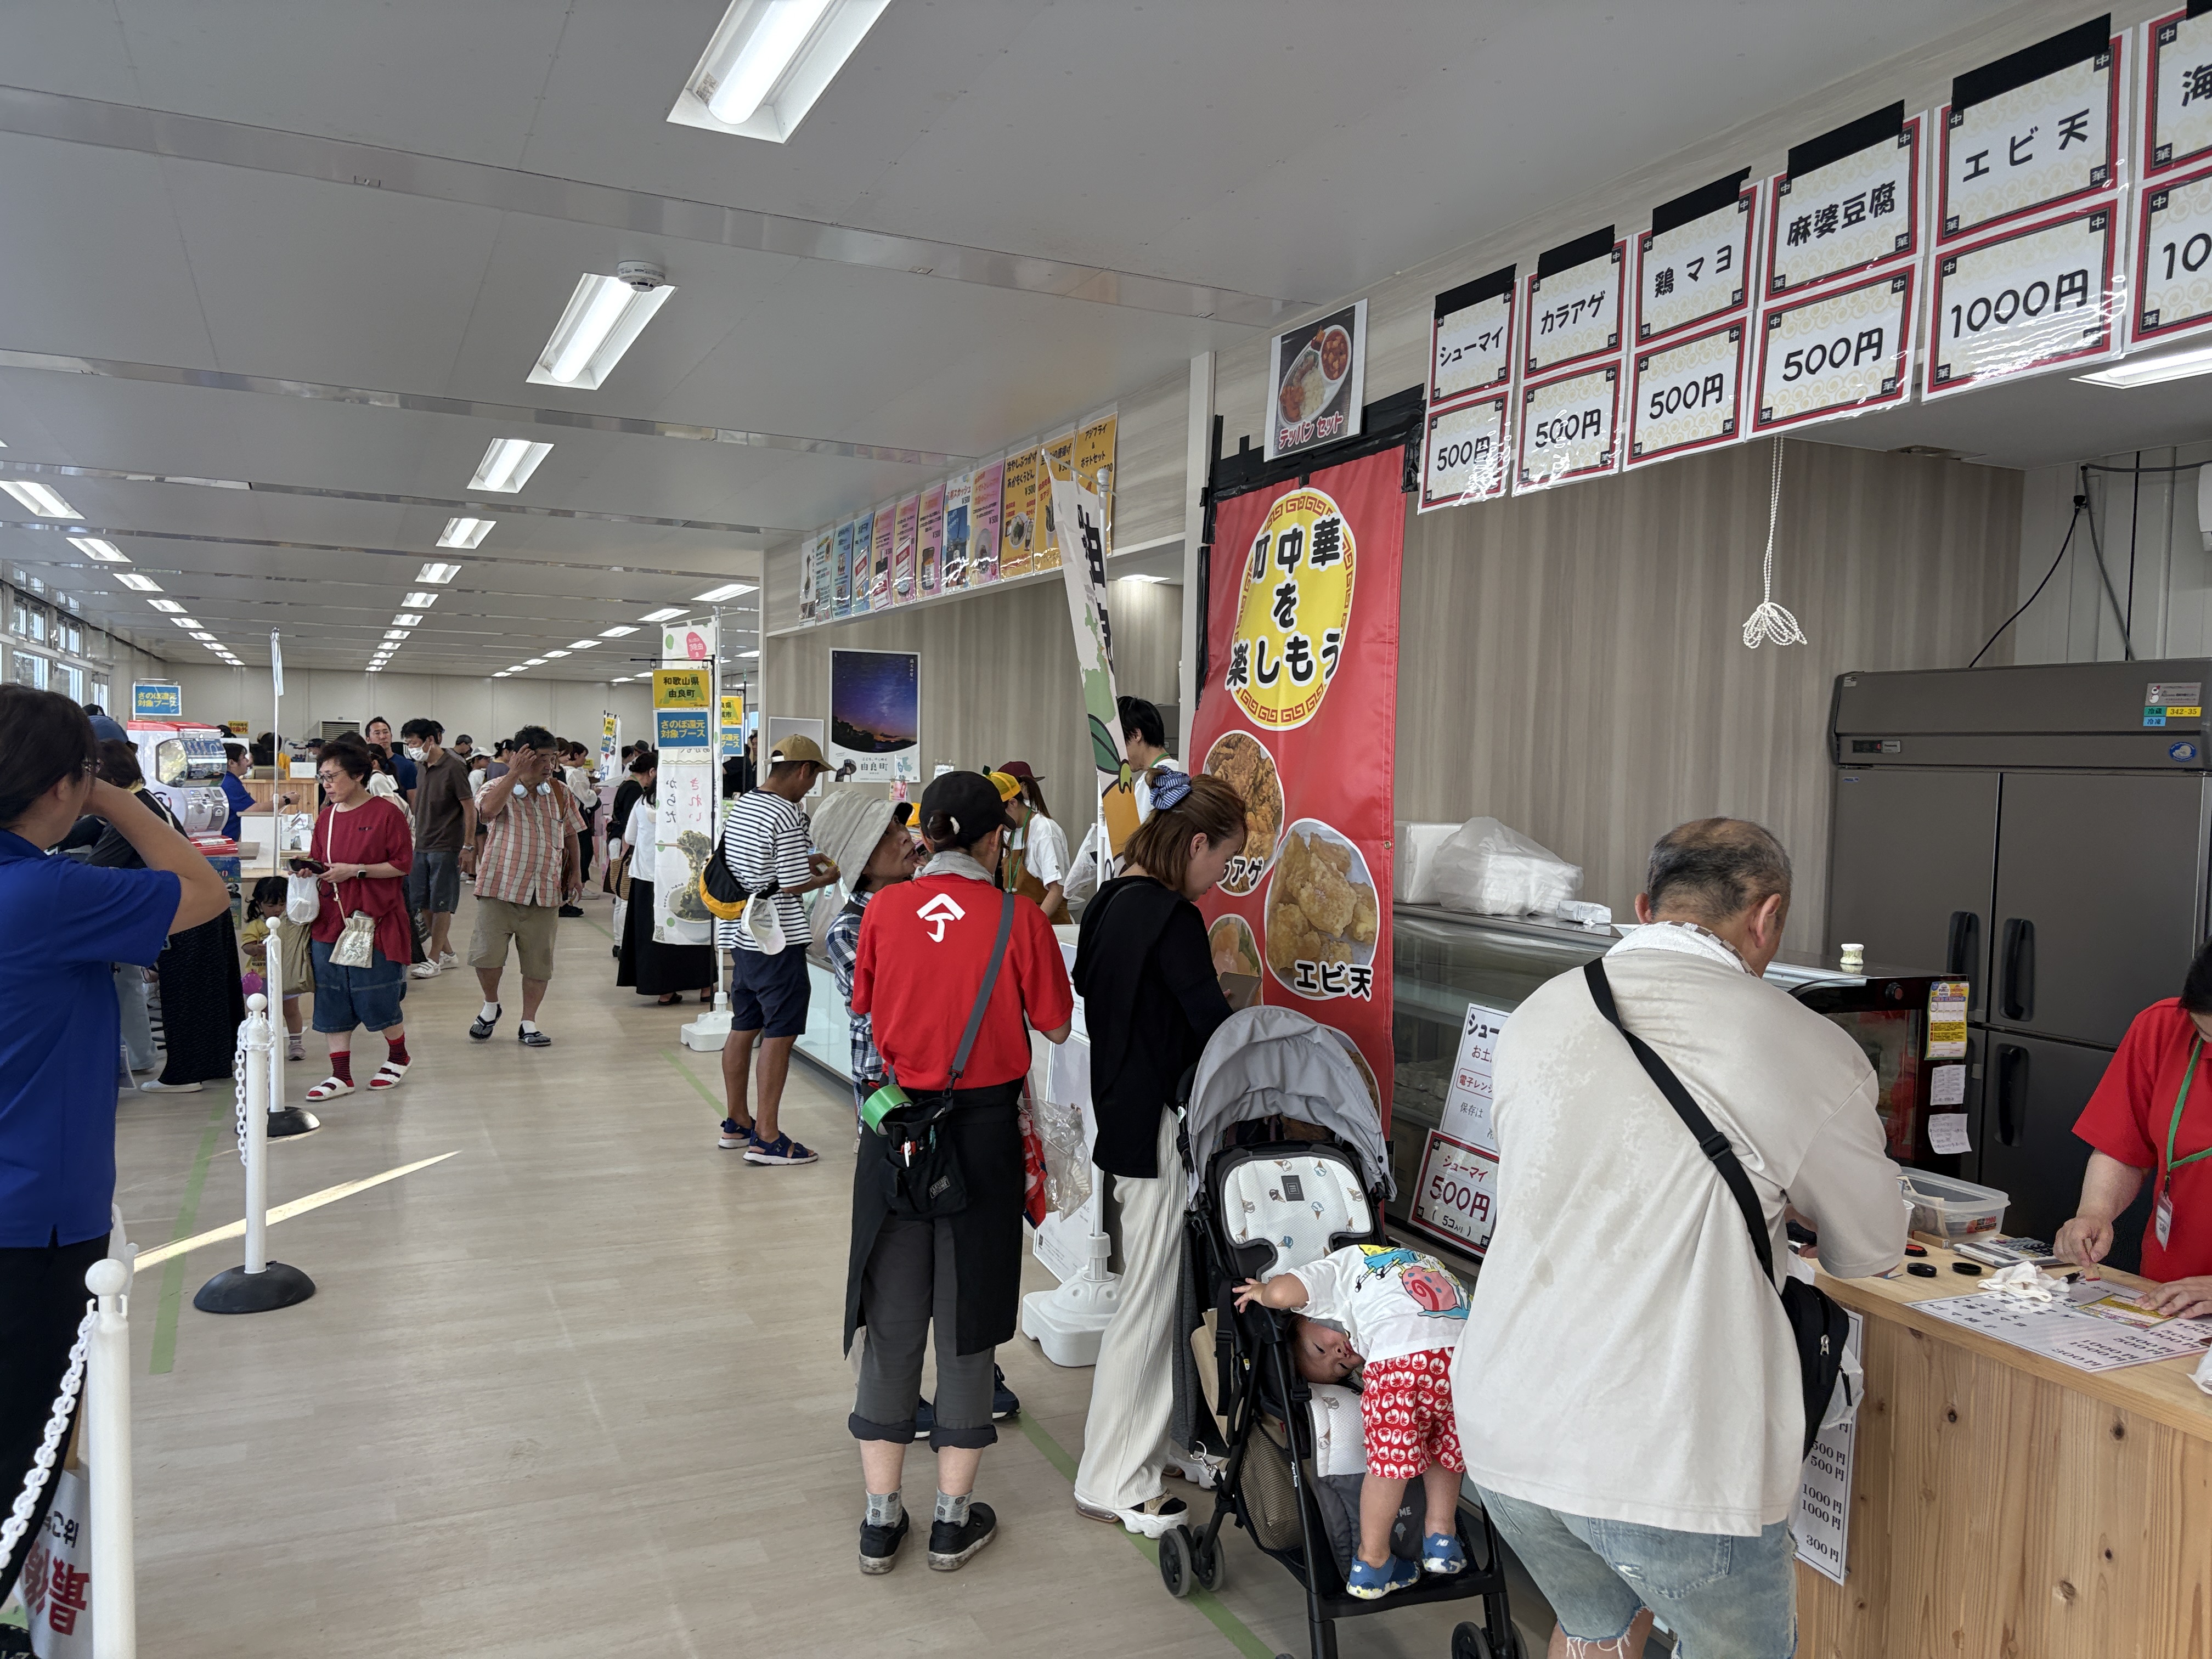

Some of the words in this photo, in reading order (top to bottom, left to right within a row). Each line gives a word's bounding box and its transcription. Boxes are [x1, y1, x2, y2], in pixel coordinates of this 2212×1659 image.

[1962, 108, 2090, 183] エビ天
[1786, 180, 1896, 247] 麻婆豆腐
[1655, 244, 1732, 298] 鶏マヨ
[1541, 290, 1606, 335] カラアゲ
[1951, 269, 2088, 338] 1000円
[1439, 326, 1504, 366] シューマイ
[1782, 328, 1883, 382] 500円
[1649, 373, 1724, 420] 500円
[1535, 409, 1602, 448] 500円
[1436, 437, 1491, 472] 500円
[1274, 583, 1298, 630] を
[1227, 633, 1340, 688] 楽しもう
[663, 676, 699, 686] 和歌山県
[668, 689, 696, 698] 由良町
[660, 729, 706, 738] 対象ブース
[1295, 962, 1372, 1000] エビ天
[1471, 1045, 1492, 1063] お土
[1460, 1102, 1483, 1119] 保存は
[1442, 1155, 1488, 1183] シューマイ
[1430, 1175, 1491, 1223] 500円
[1810, 1455, 1844, 1482] 500円
[1802, 1499, 1841, 1531] 1000円
[1803, 1483, 1842, 1515] 1000円
[1806, 1534, 1839, 1563] 300円
